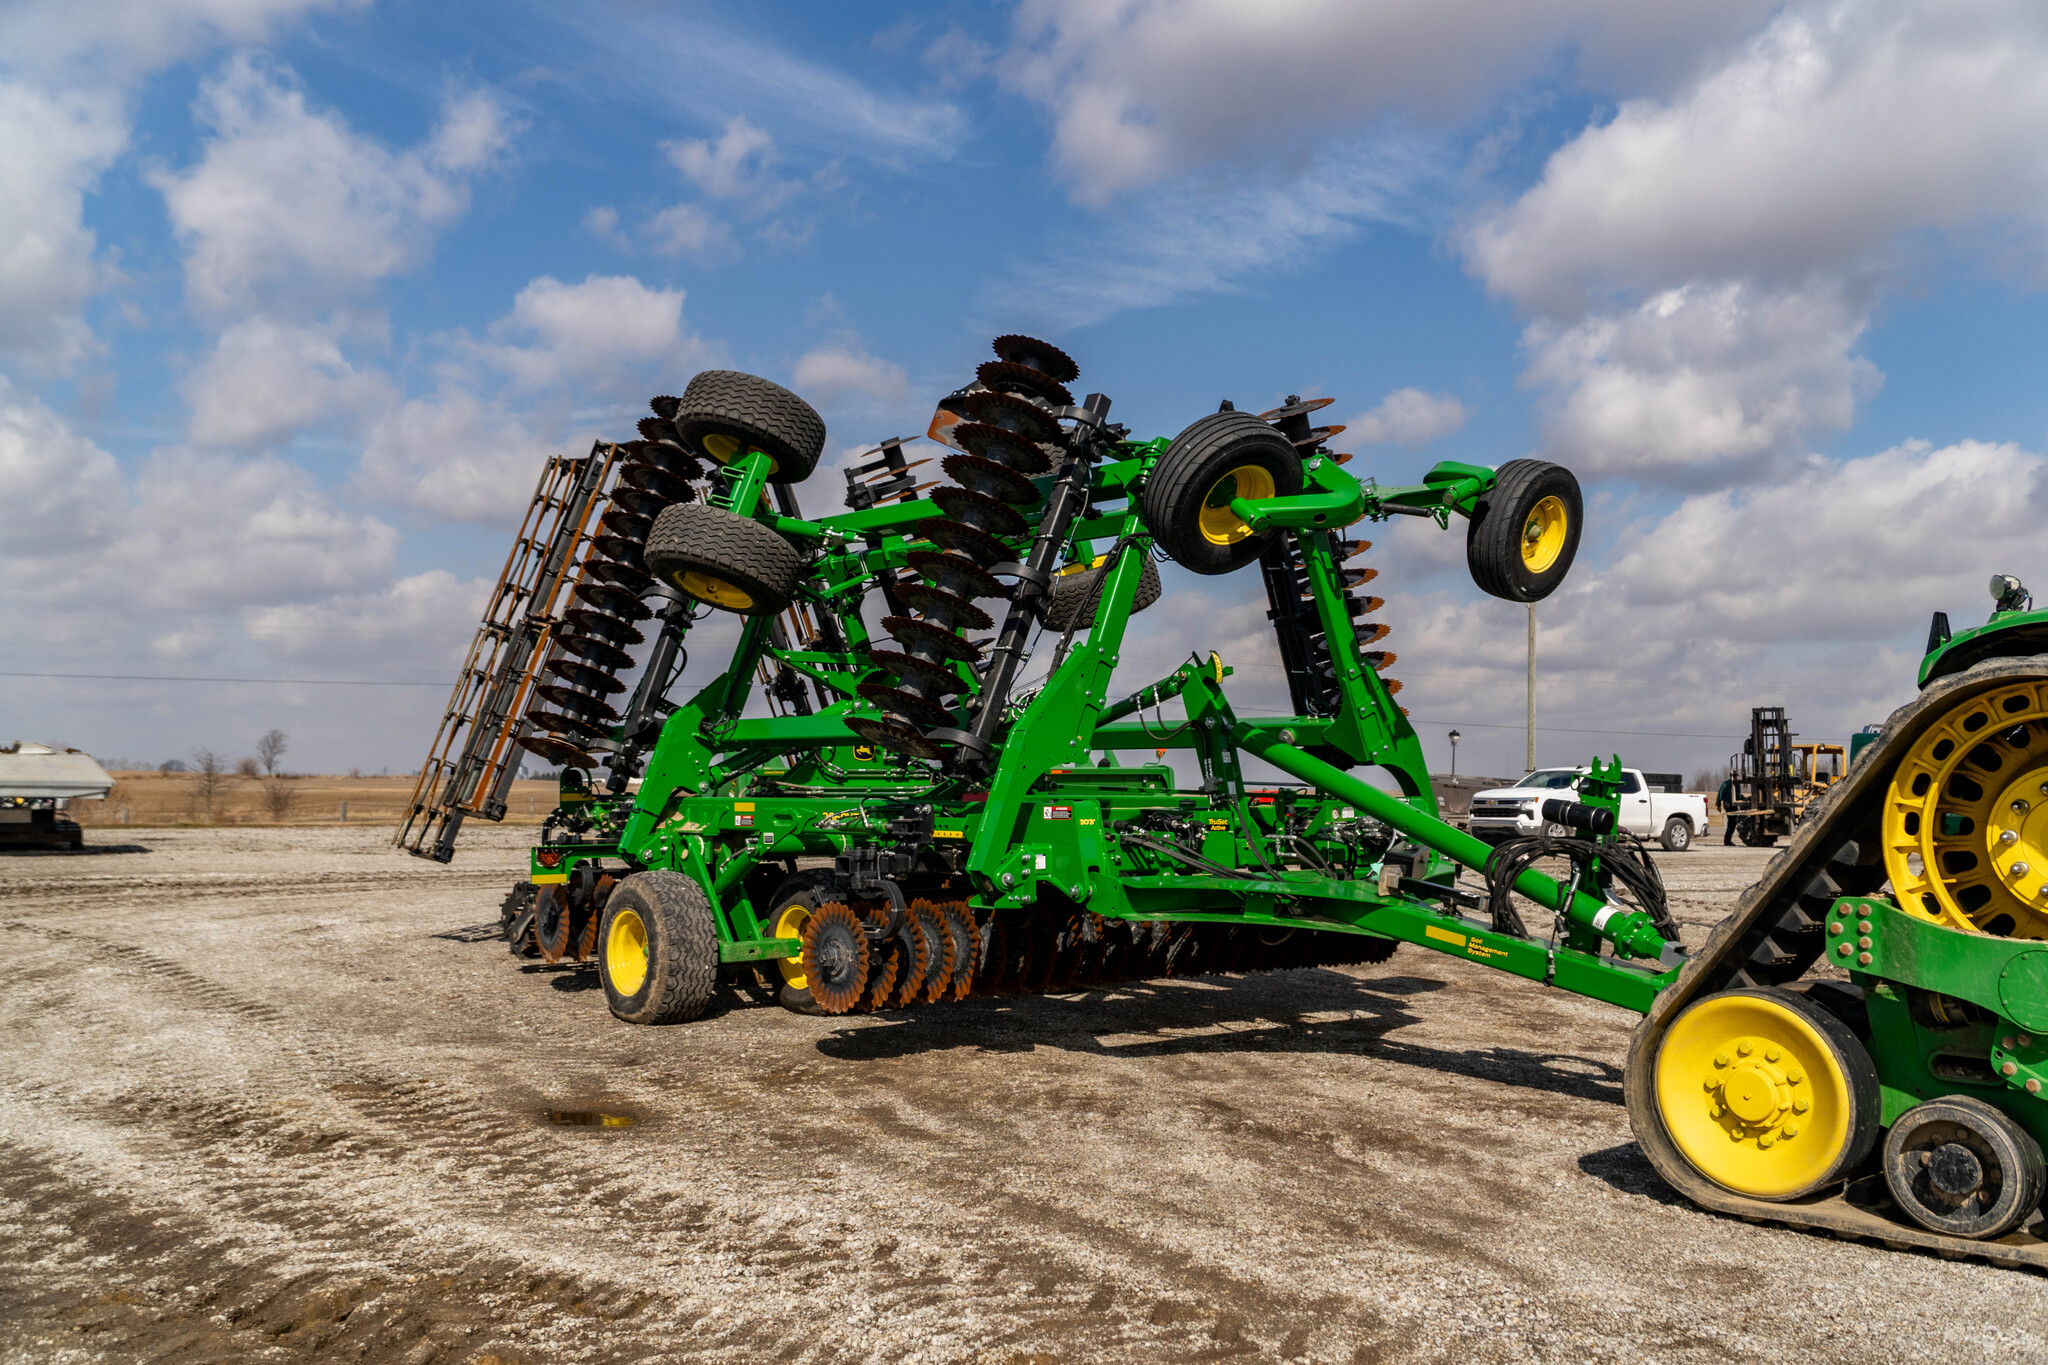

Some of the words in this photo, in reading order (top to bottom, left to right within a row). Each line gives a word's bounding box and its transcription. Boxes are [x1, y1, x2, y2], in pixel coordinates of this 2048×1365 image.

[1470, 936, 1483, 945] Soil
[1467, 947, 1491, 958] System
[1468, 942, 1509, 957] Management
